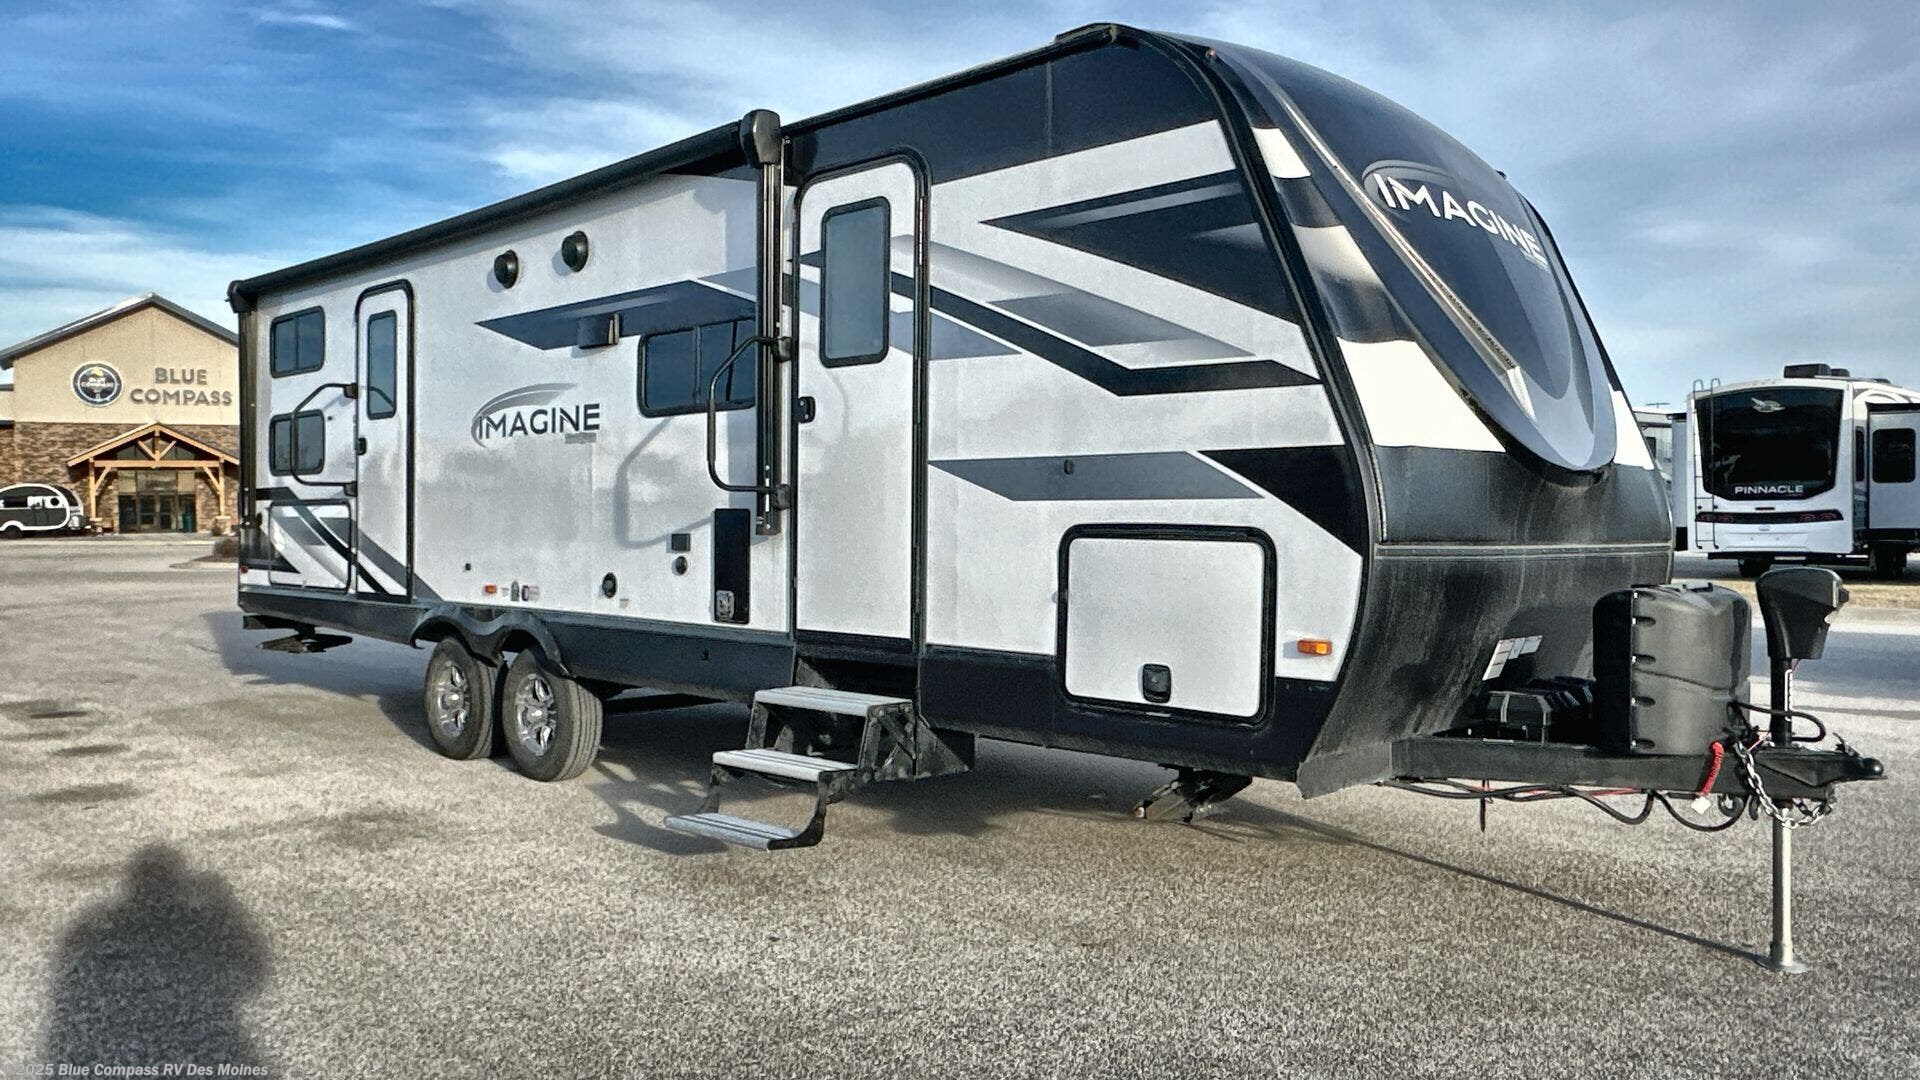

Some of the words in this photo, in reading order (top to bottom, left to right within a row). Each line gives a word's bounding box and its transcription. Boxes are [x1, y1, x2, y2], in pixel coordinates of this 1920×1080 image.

[1373, 172, 1548, 266] IMAGINE
[154, 367, 207, 385] BLUE
[130, 388, 233, 406] COMPASS
[478, 402, 600, 440] IMAGINE
[1734, 485, 1804, 494] PINNACLE
